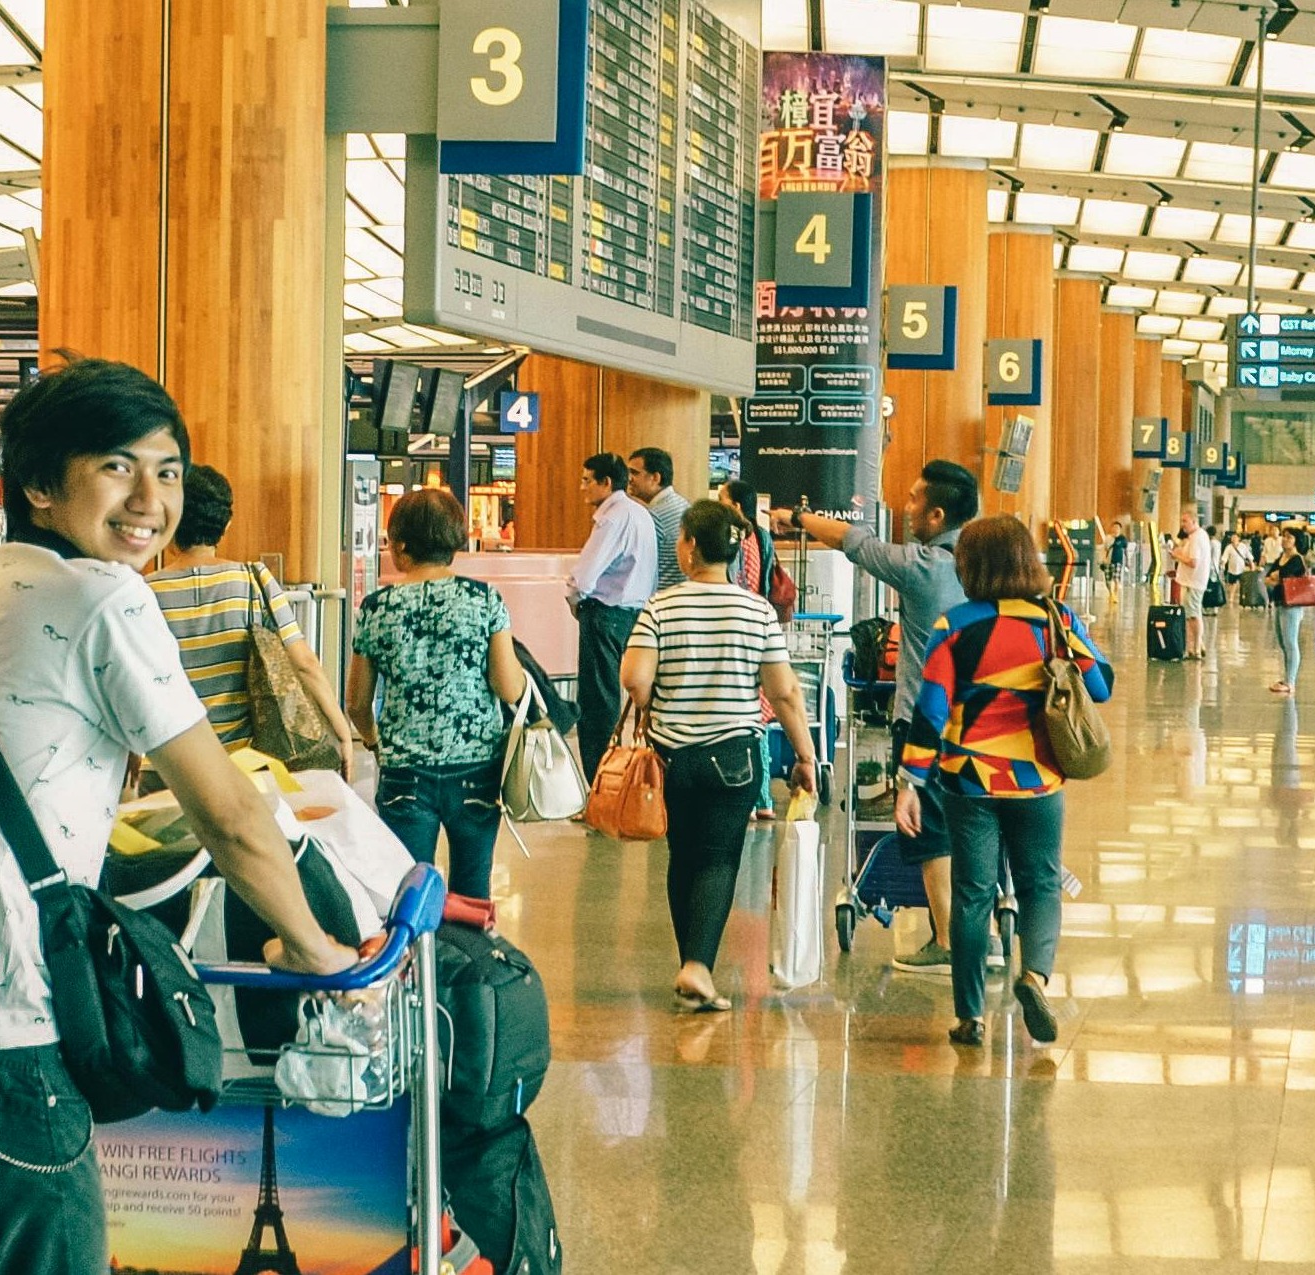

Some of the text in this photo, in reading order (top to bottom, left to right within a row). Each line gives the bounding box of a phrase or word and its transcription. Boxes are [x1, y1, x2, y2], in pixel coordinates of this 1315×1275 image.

[470, 27, 523, 106] 3
[795, 214, 831, 264] 4
[901, 302, 928, 339] 5
[1280, 319, 1300, 331] GST
[1280, 346, 1313, 358] Money
[998, 352, 1020, 382] 6
[1280, 372, 1303, 384] Baby
[506, 396, 533, 429] 4
[1140, 425, 1155, 444] 7
[1167, 437, 1180, 455] 8
[1206, 447, 1218, 463] 9
[814, 510, 864, 521] CHANGI
[102, 1143, 246, 1165] WIN FREE FLIGHTS
[99, 1163, 221, 1183] ANGI REWARDS
[104, 1187, 235, 1204] ngirewards.com for your
[124, 1203, 143, 1213] and
[146, 1204, 185, 1214] receive
[188, 1204, 202, 1215] 50
[203, 1205, 241, 1217] points!
